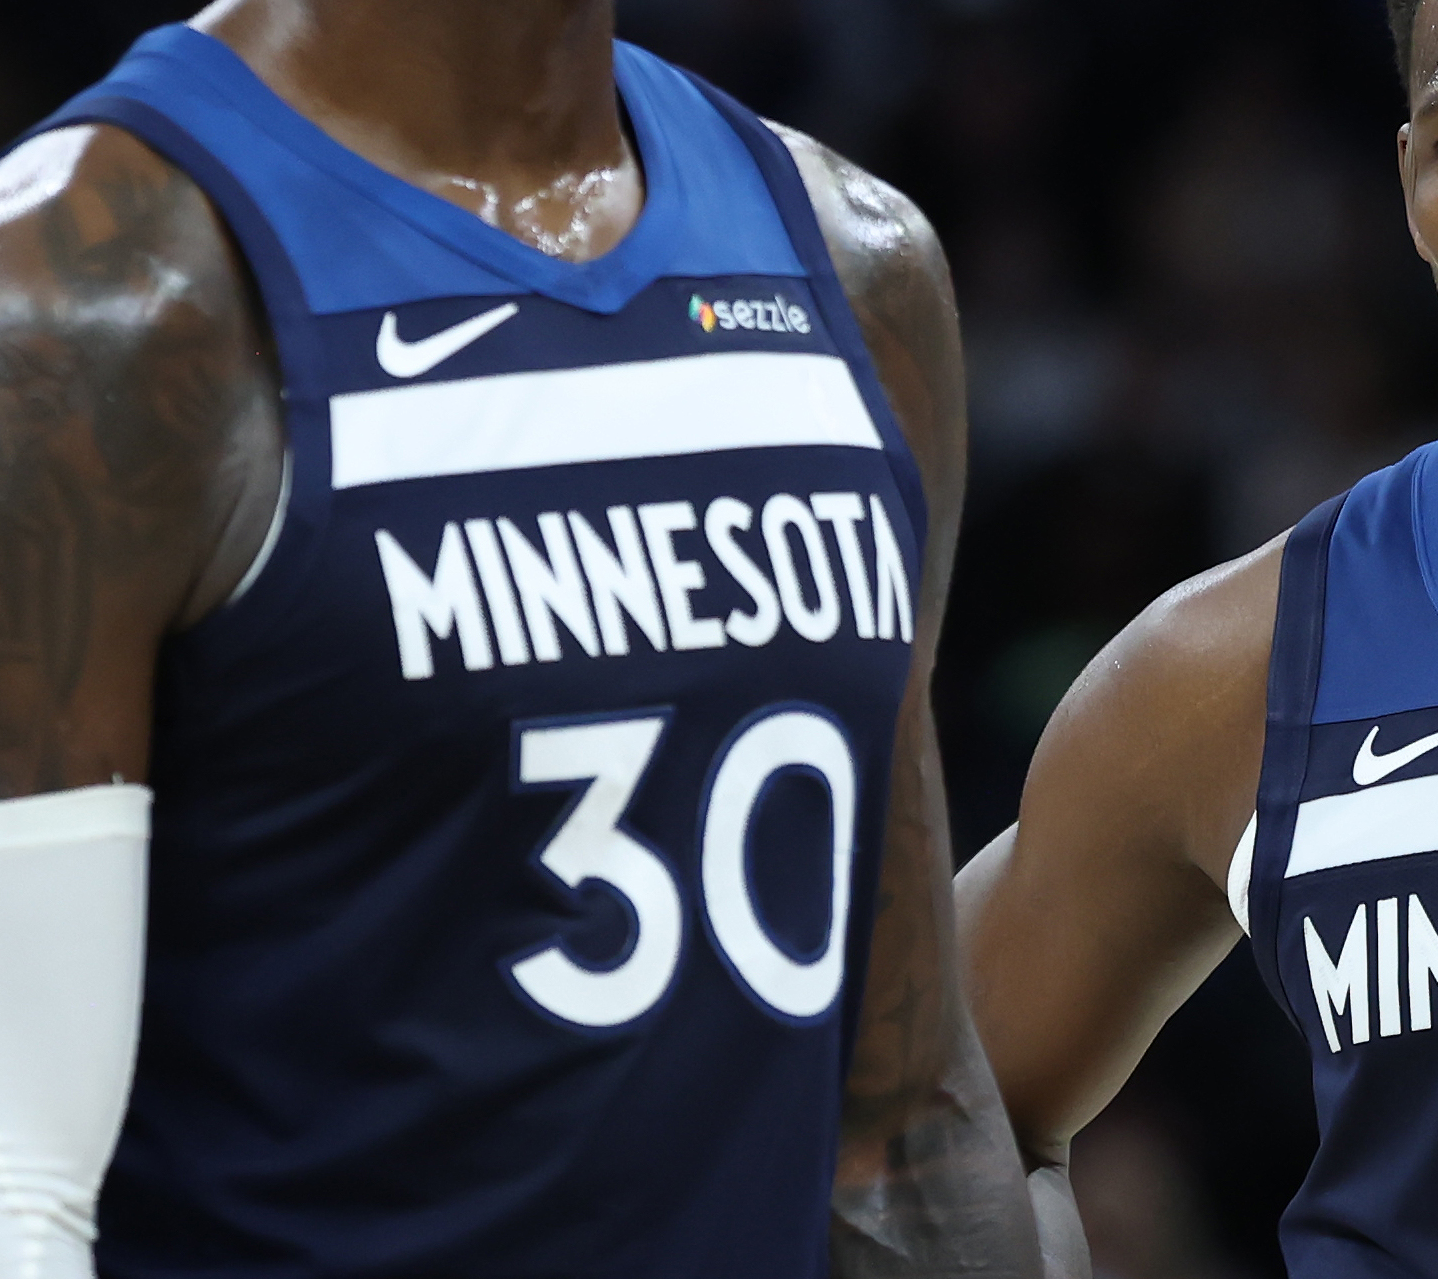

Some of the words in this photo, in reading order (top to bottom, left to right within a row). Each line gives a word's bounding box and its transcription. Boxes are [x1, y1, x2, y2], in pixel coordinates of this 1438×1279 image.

[713, 292, 811, 333] sezzle
[375, 492, 913, 680] MINNESOTA
[511, 711, 856, 1026] 30
